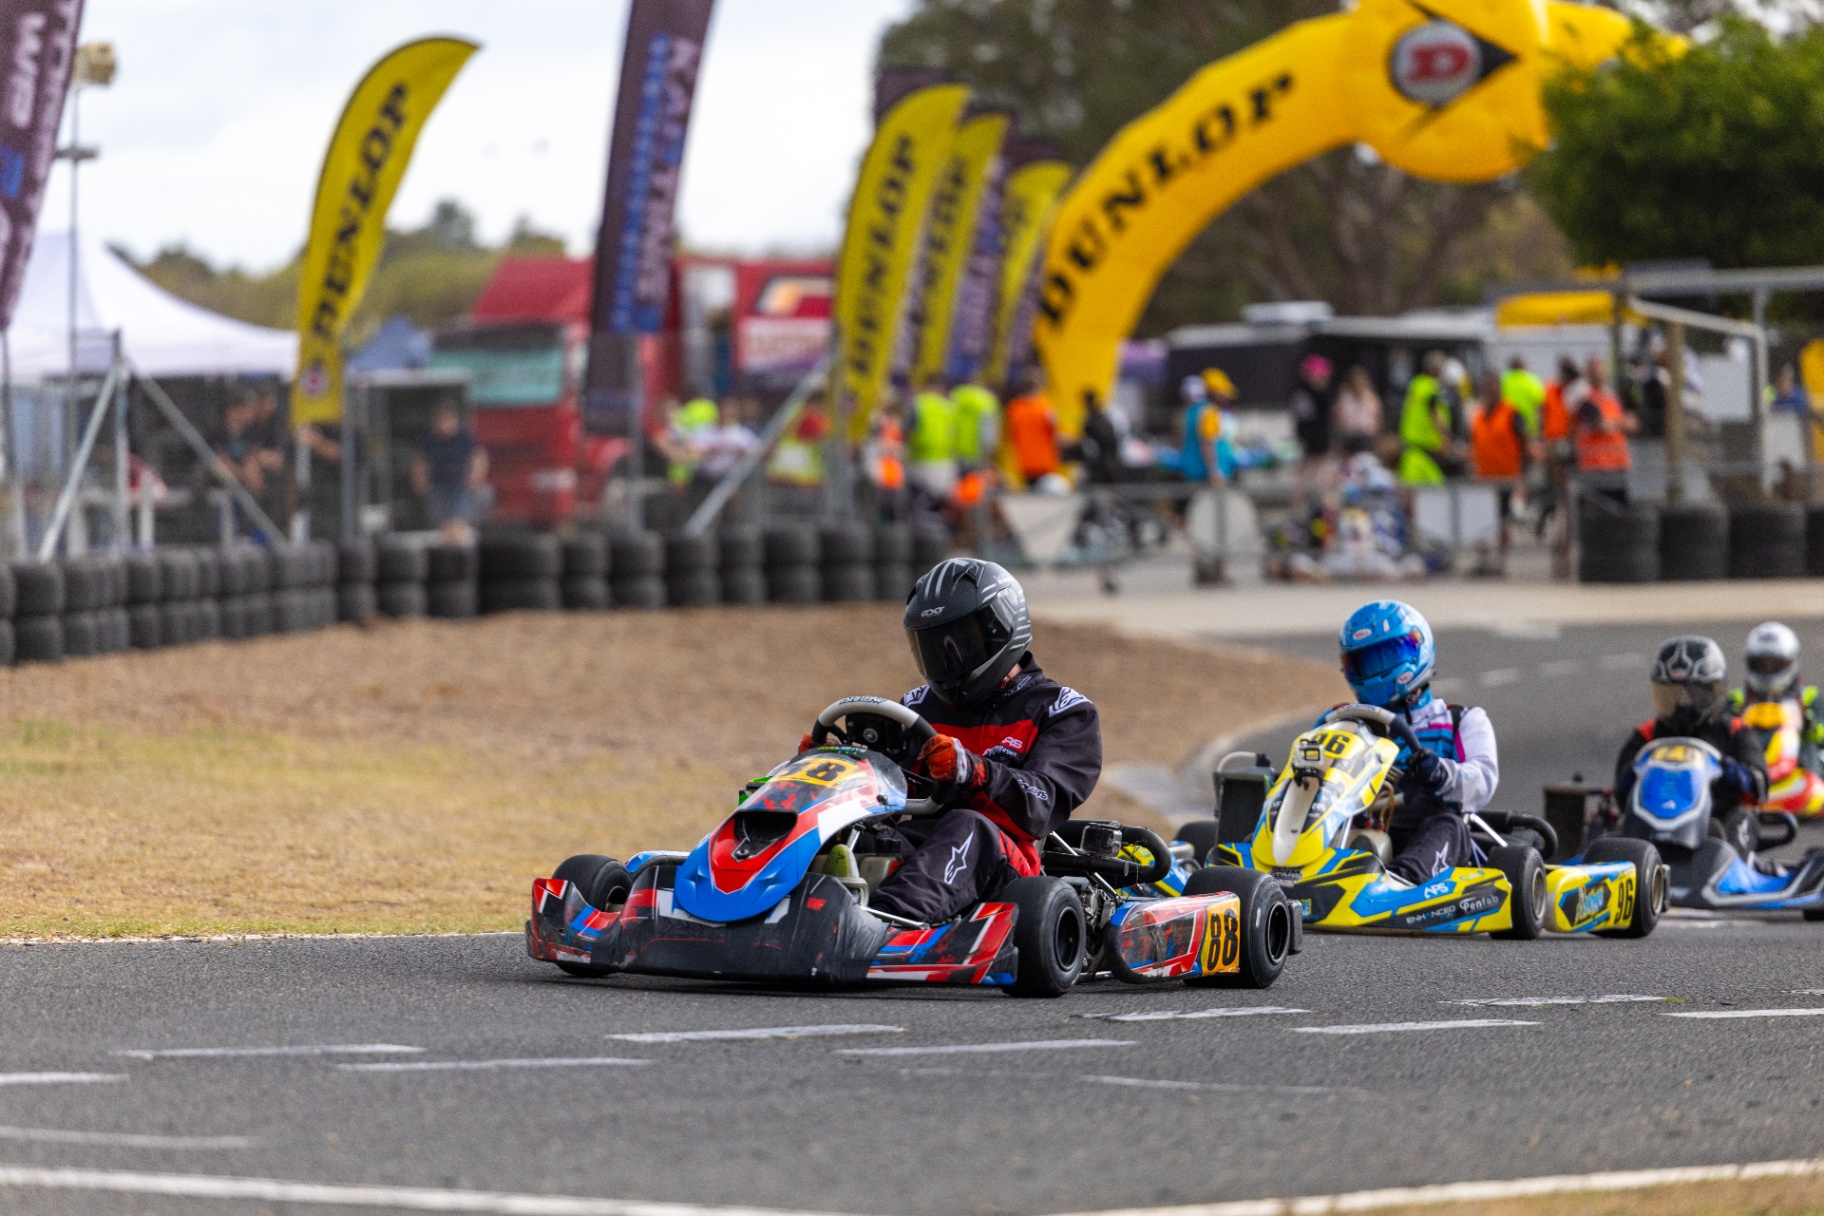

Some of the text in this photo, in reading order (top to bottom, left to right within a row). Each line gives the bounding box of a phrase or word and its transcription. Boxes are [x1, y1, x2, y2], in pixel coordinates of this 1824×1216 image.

[1407, 42, 1473, 83] D
[311, 82, 408, 344] DUNLOP
[1034, 72, 1293, 332] DUNLOP
[851, 132, 914, 377] DUNLOP
[1311, 733, 1350, 754] 96
[1406, 905, 1456, 924] ENHANCED
[1614, 878, 1634, 924] 96
[1207, 908, 1238, 971] 88
